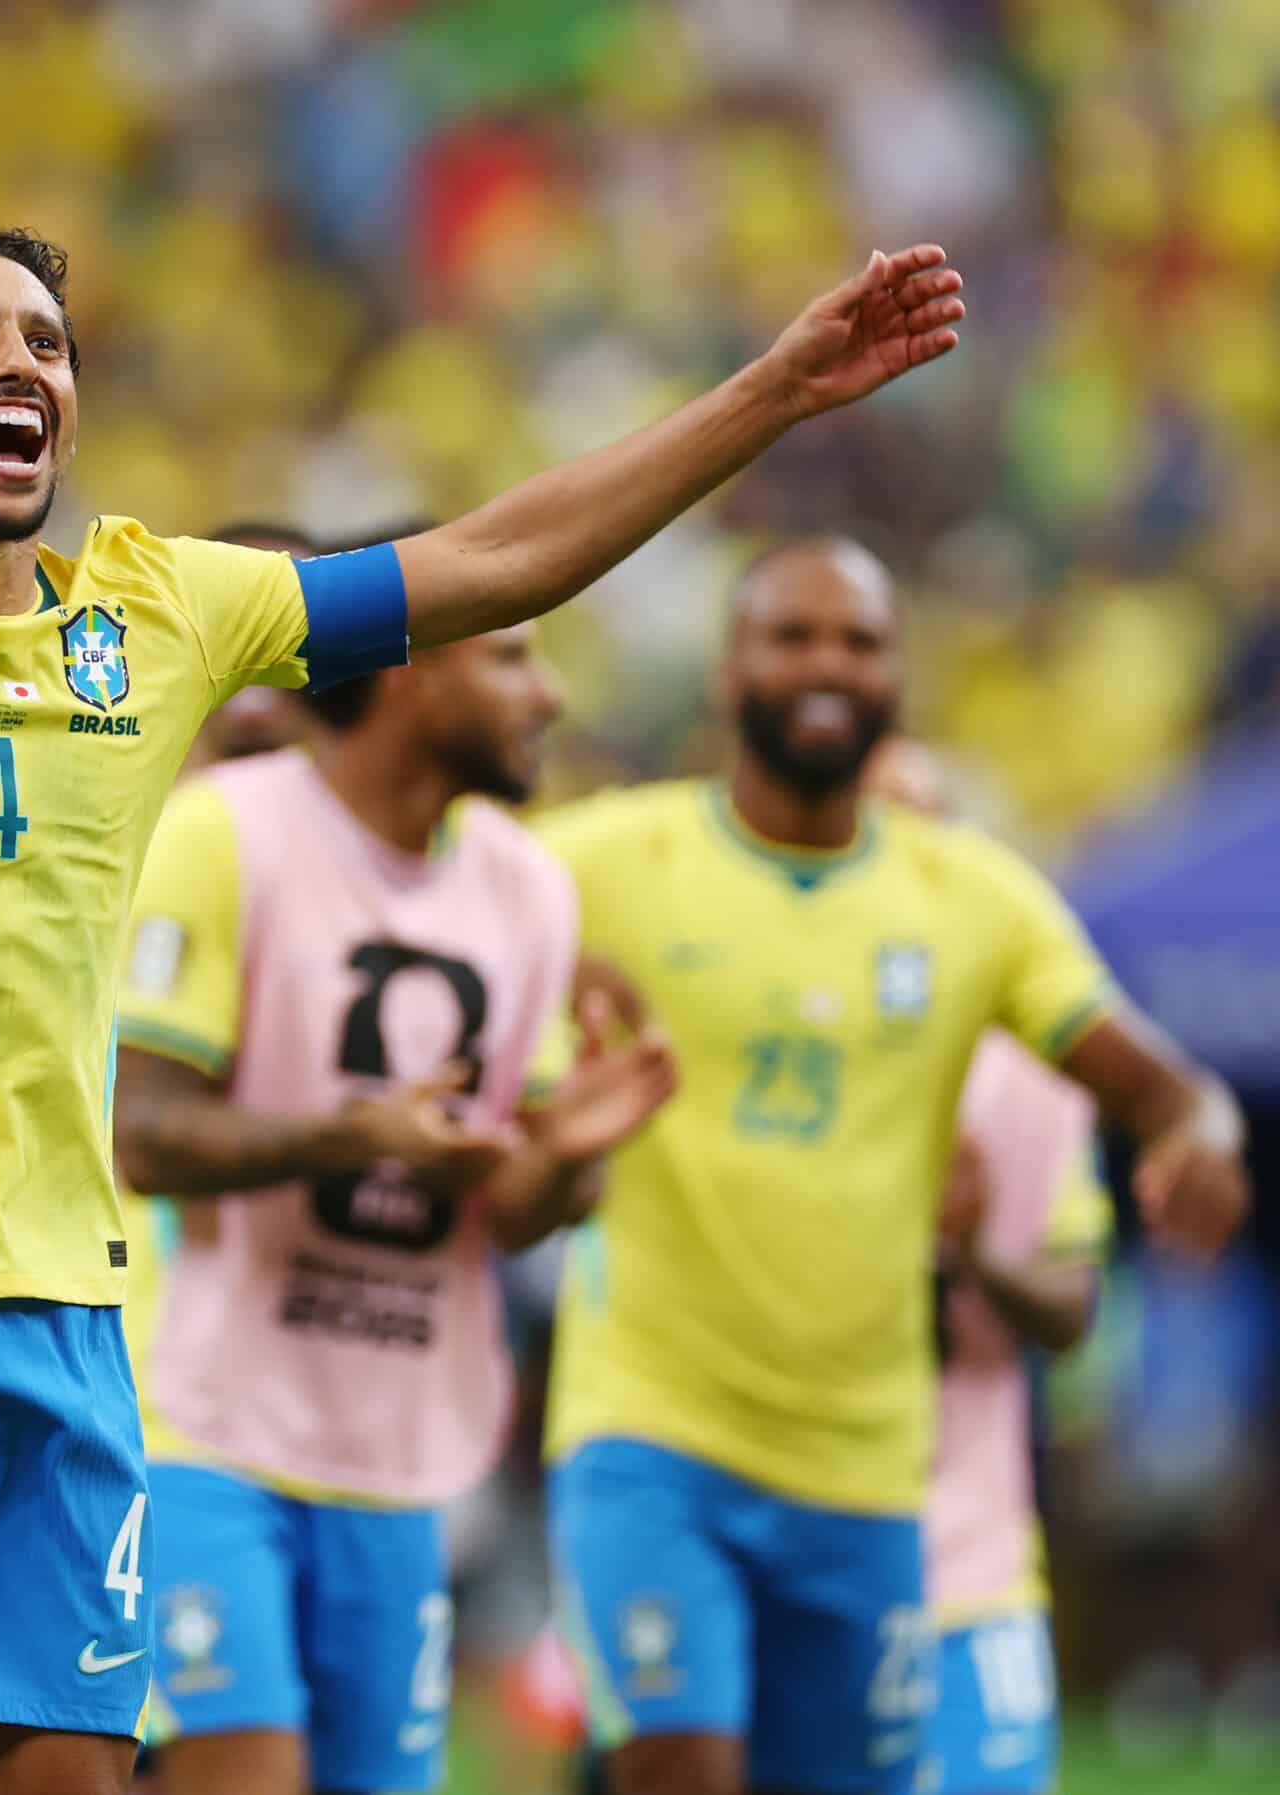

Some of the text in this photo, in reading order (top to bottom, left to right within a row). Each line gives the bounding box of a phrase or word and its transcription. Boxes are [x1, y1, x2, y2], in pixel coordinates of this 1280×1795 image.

[82, 650, 107, 663] CBF
[69, 714, 141, 736] BRASIL
[103, 1492, 147, 1621] 4
